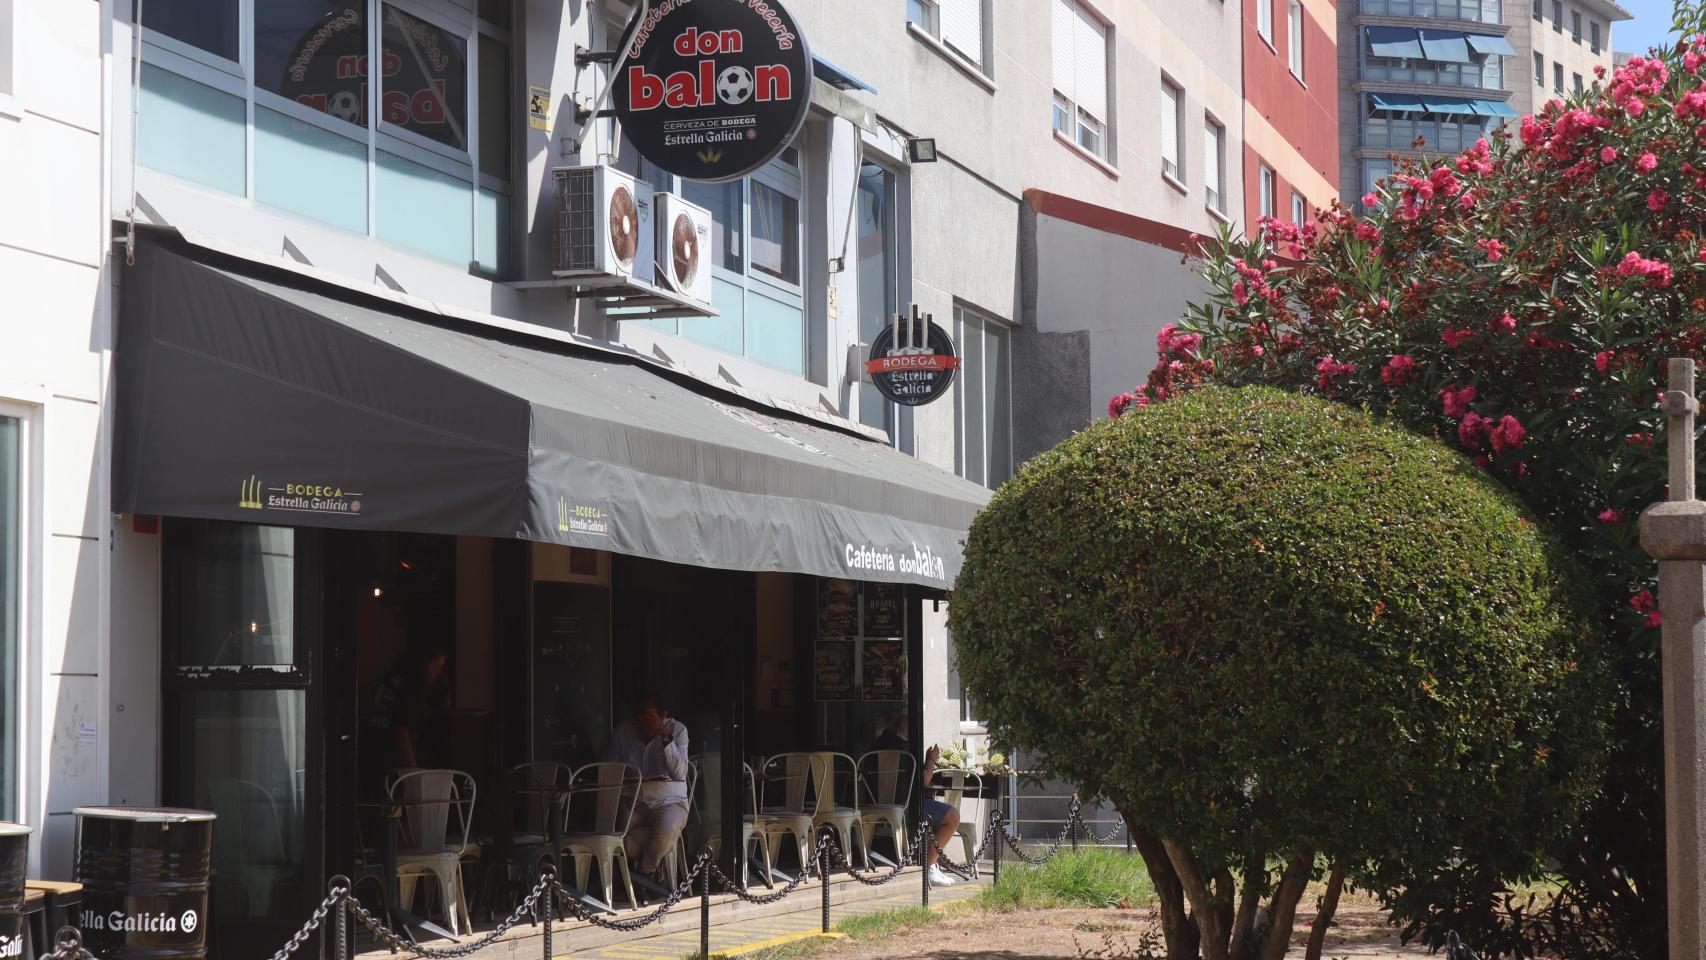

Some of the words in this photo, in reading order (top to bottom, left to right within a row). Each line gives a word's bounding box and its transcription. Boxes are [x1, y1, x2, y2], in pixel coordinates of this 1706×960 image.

[674, 27, 743, 56] don
[664, 121, 706, 130] CERVEZA
[721, 117, 756, 126] BODEGA
[664, 133, 704, 146] Estrella
[706, 130, 743, 143] Galicia
[883, 356, 937, 368] BODEGA
[891, 371, 933, 382] Estrella
[892, 382, 932, 395] Galicia
[286, 484, 344, 497] BODEGA
[268, 495, 309, 509] Estrella
[310, 497, 348, 511] Galicia
[108, 910, 177, 932] Galicia
